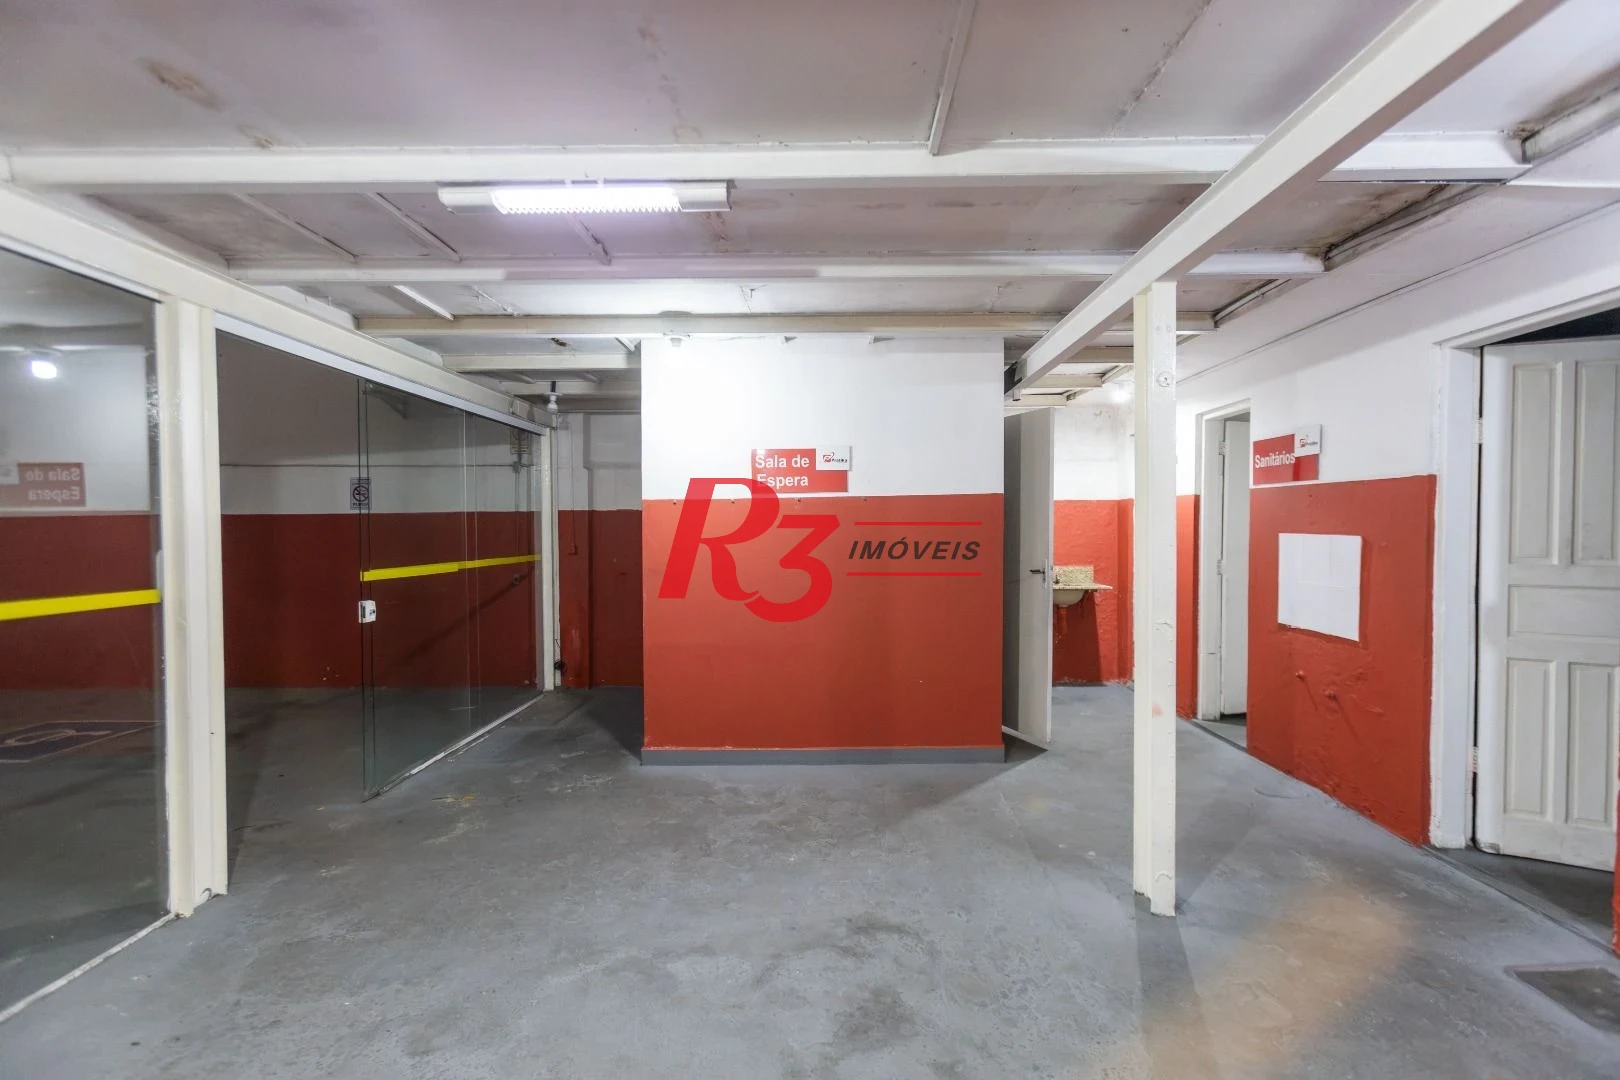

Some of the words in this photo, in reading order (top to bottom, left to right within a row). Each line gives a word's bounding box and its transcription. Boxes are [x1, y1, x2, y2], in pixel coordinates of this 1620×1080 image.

[755, 453, 787, 468] Sala
[791, 454, 810, 468] de
[1254, 450, 1296, 469] Sanitários
